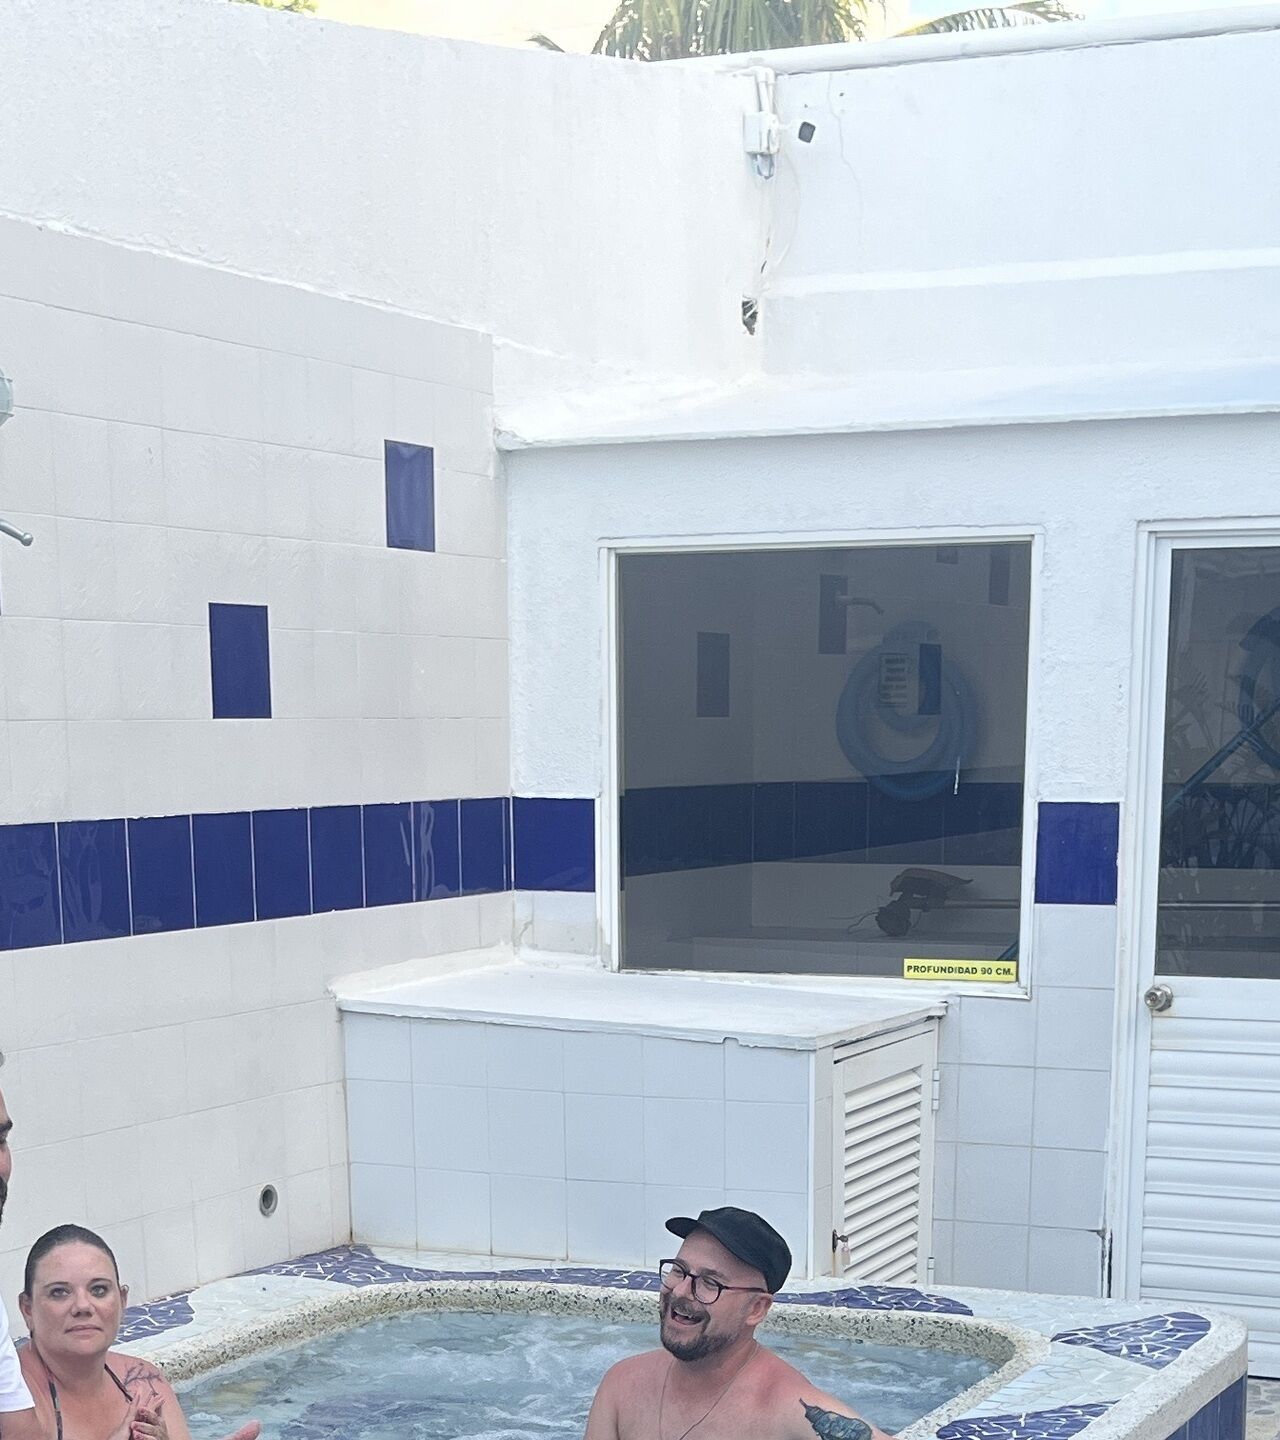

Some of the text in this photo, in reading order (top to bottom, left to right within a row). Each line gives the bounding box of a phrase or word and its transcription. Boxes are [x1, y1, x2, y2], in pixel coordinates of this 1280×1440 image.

[907, 965, 1014, 976] PROFUNDIDAD 90 CM.
